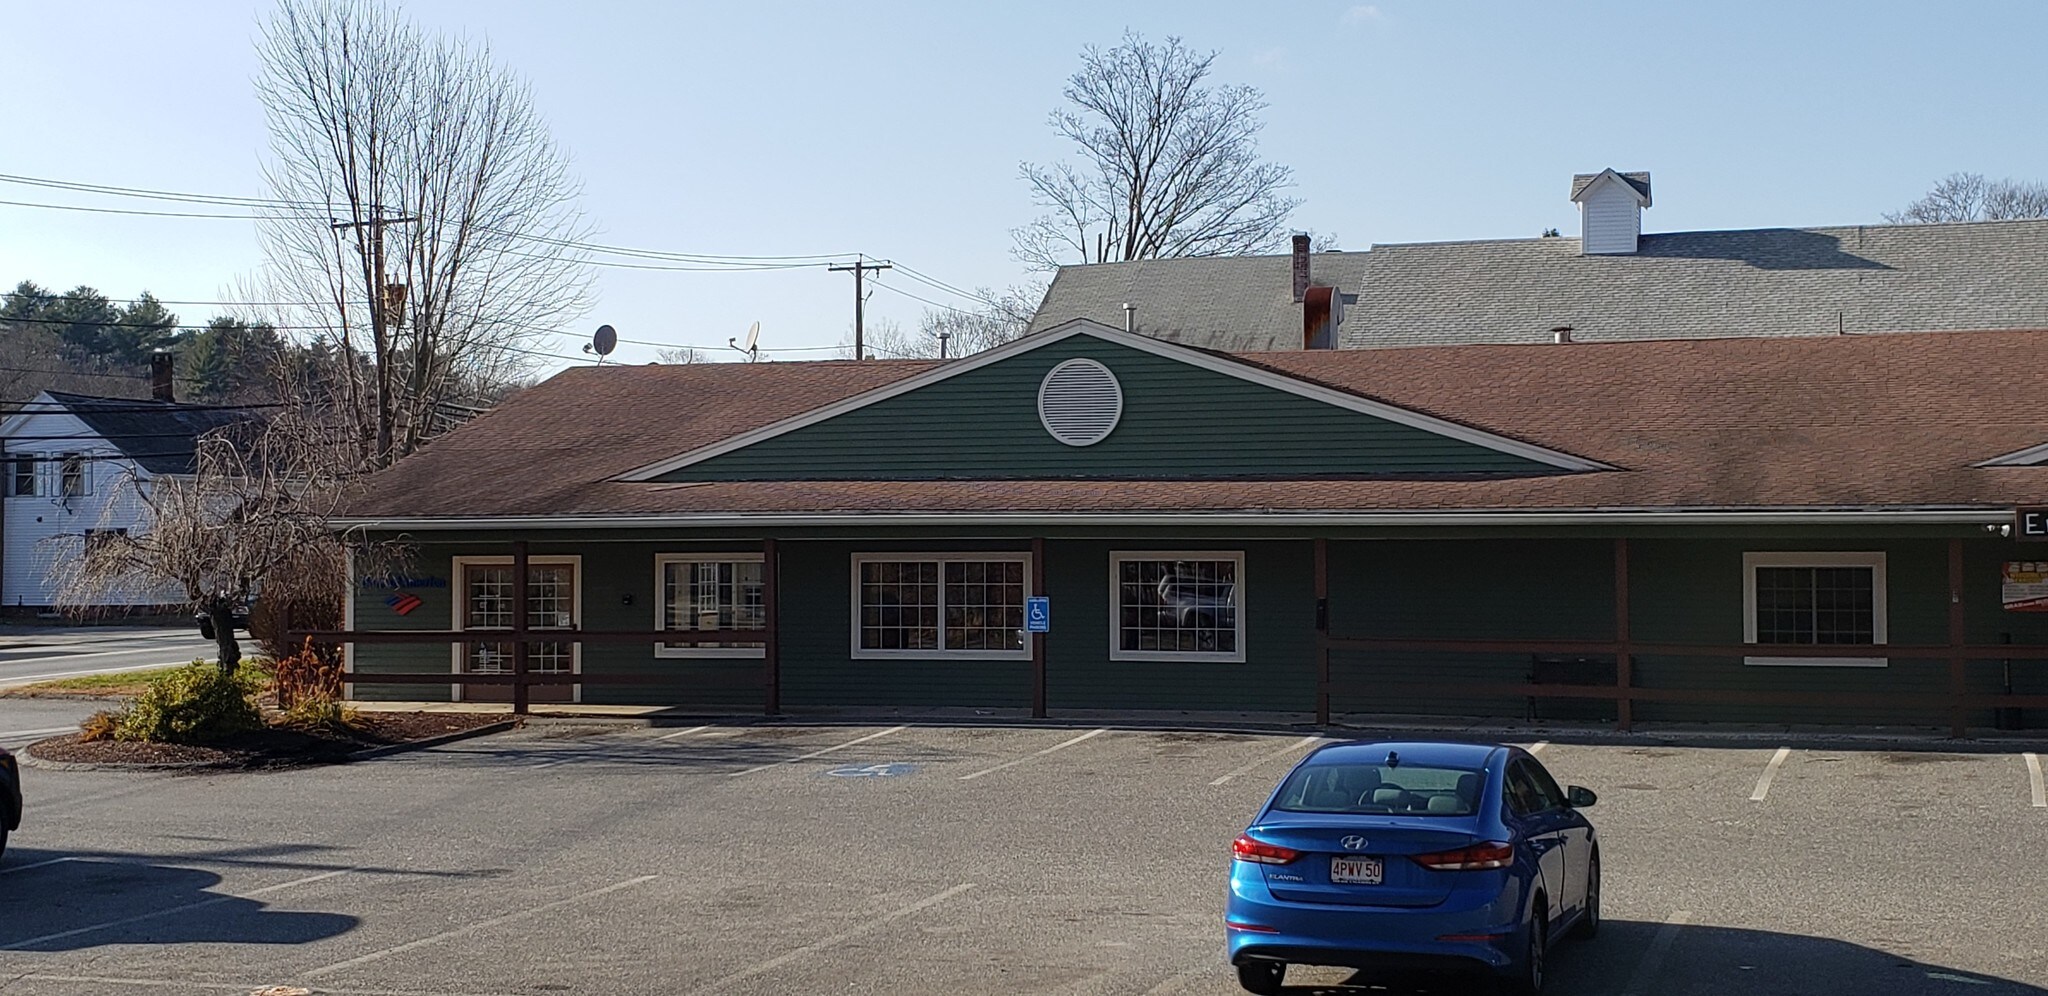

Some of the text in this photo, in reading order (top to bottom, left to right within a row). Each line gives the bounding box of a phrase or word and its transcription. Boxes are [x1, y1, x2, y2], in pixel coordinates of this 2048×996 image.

[2025, 513, 2048, 534] E
[1269, 873, 1304, 882] ELANTRA
[1333, 861, 1380, 878] 4PWV 50
